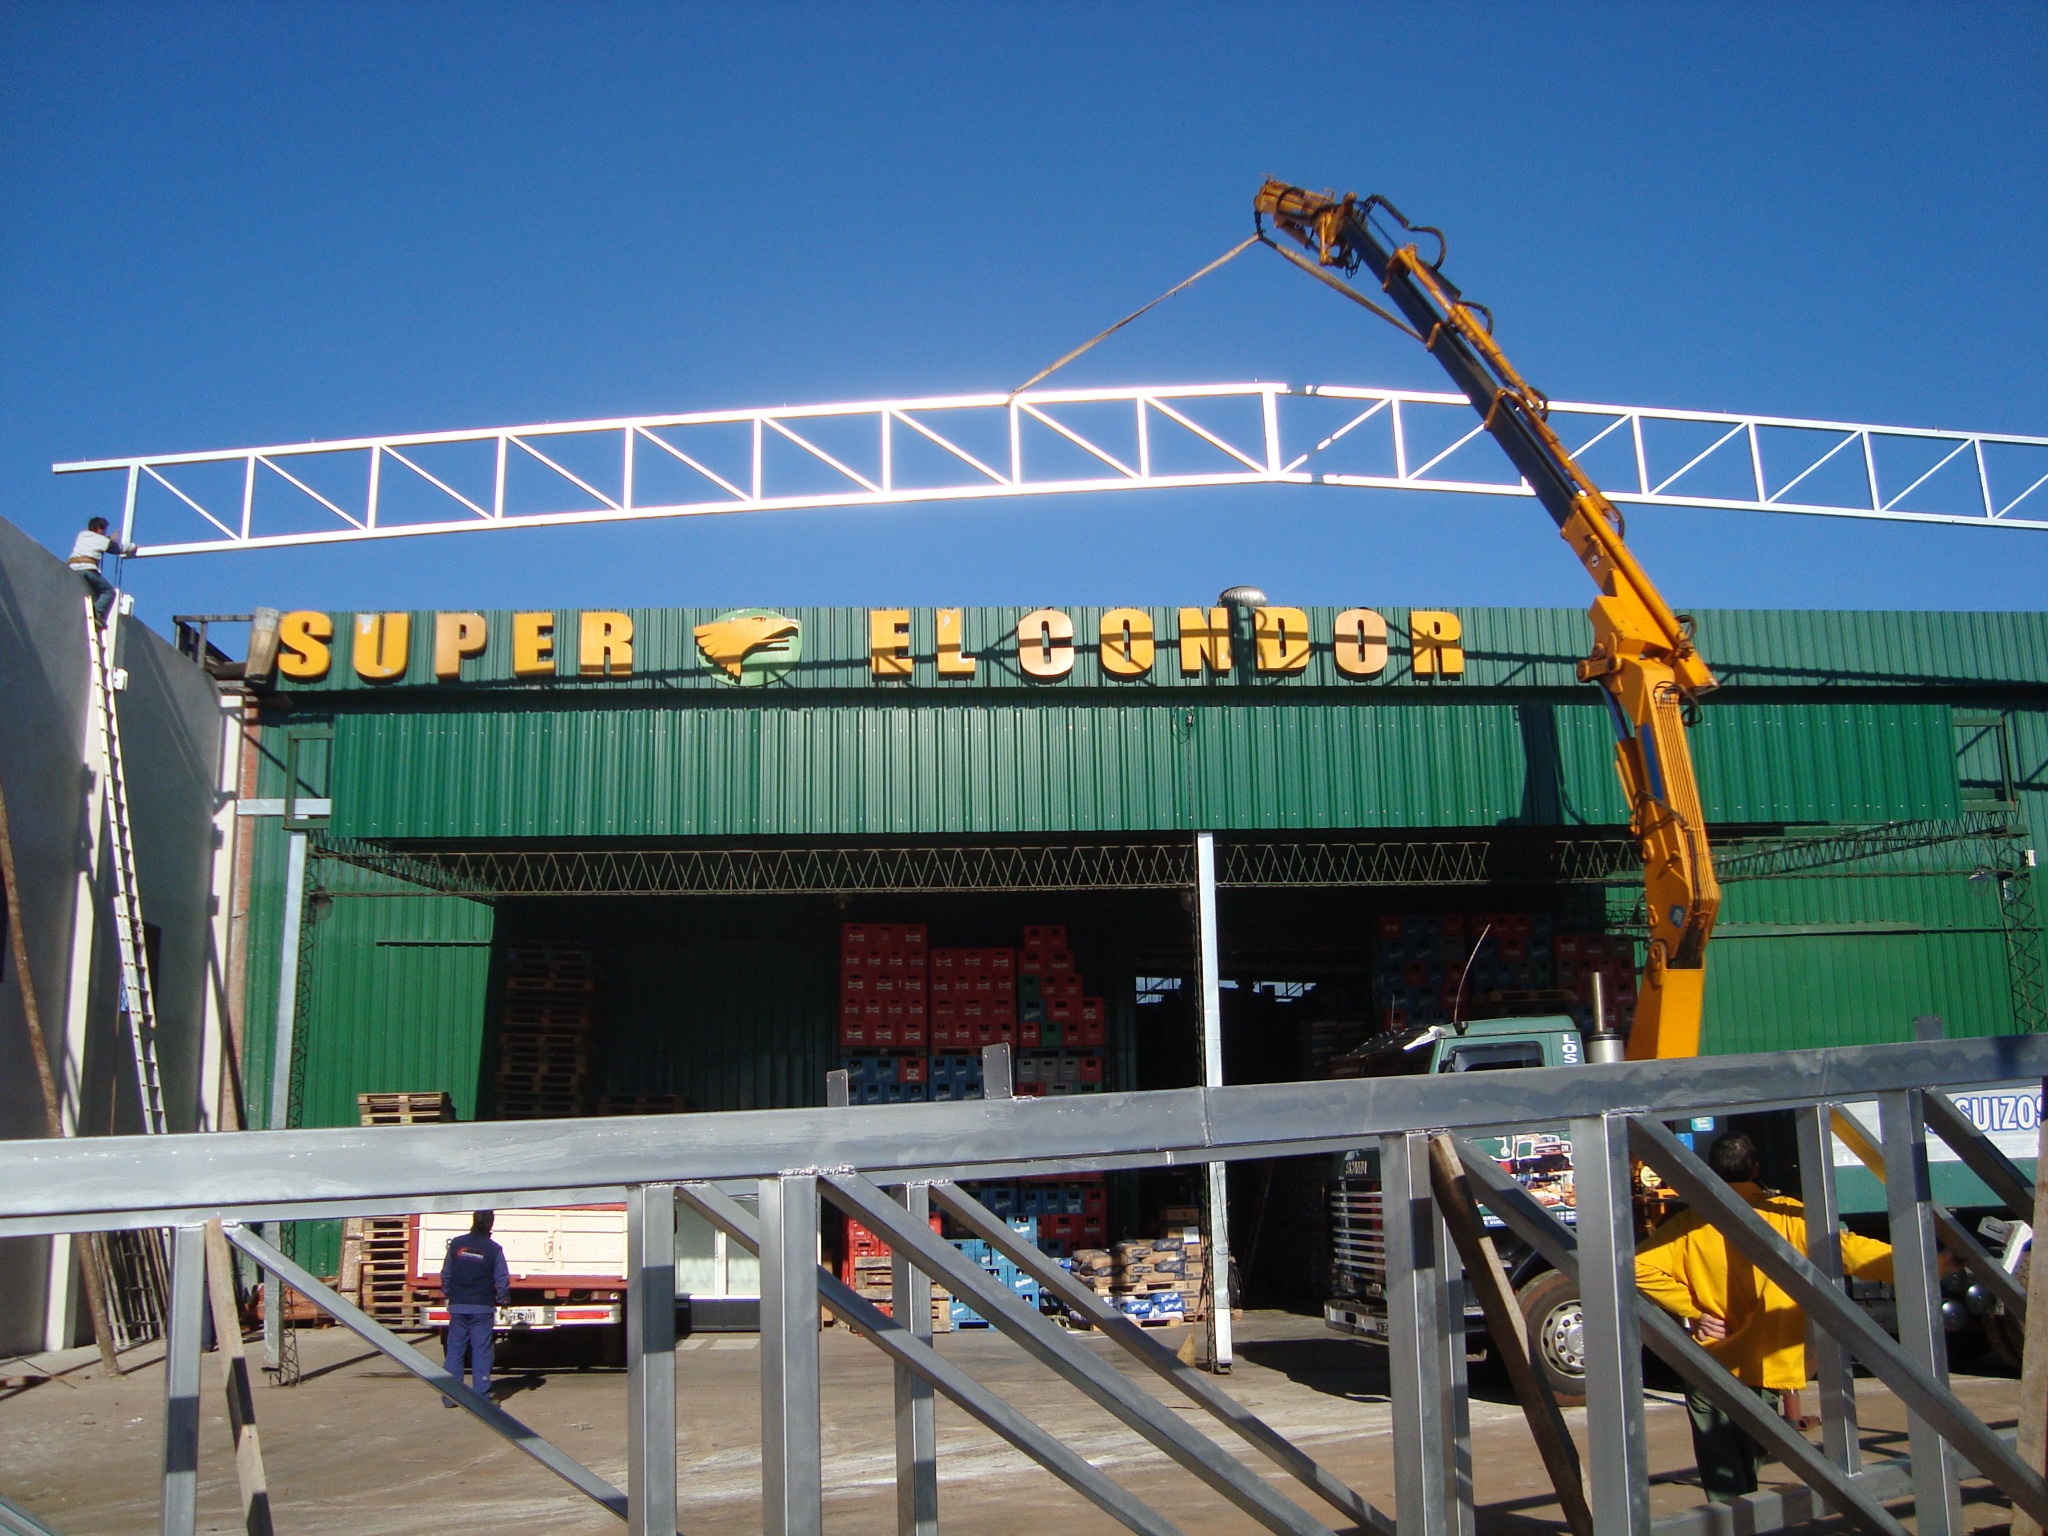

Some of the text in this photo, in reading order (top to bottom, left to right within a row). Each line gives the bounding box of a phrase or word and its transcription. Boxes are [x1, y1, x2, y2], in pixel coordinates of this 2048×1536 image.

[277, 607, 1465, 679] SUPER EL CONDOR
[1562, 1033, 1578, 1064] LOS
